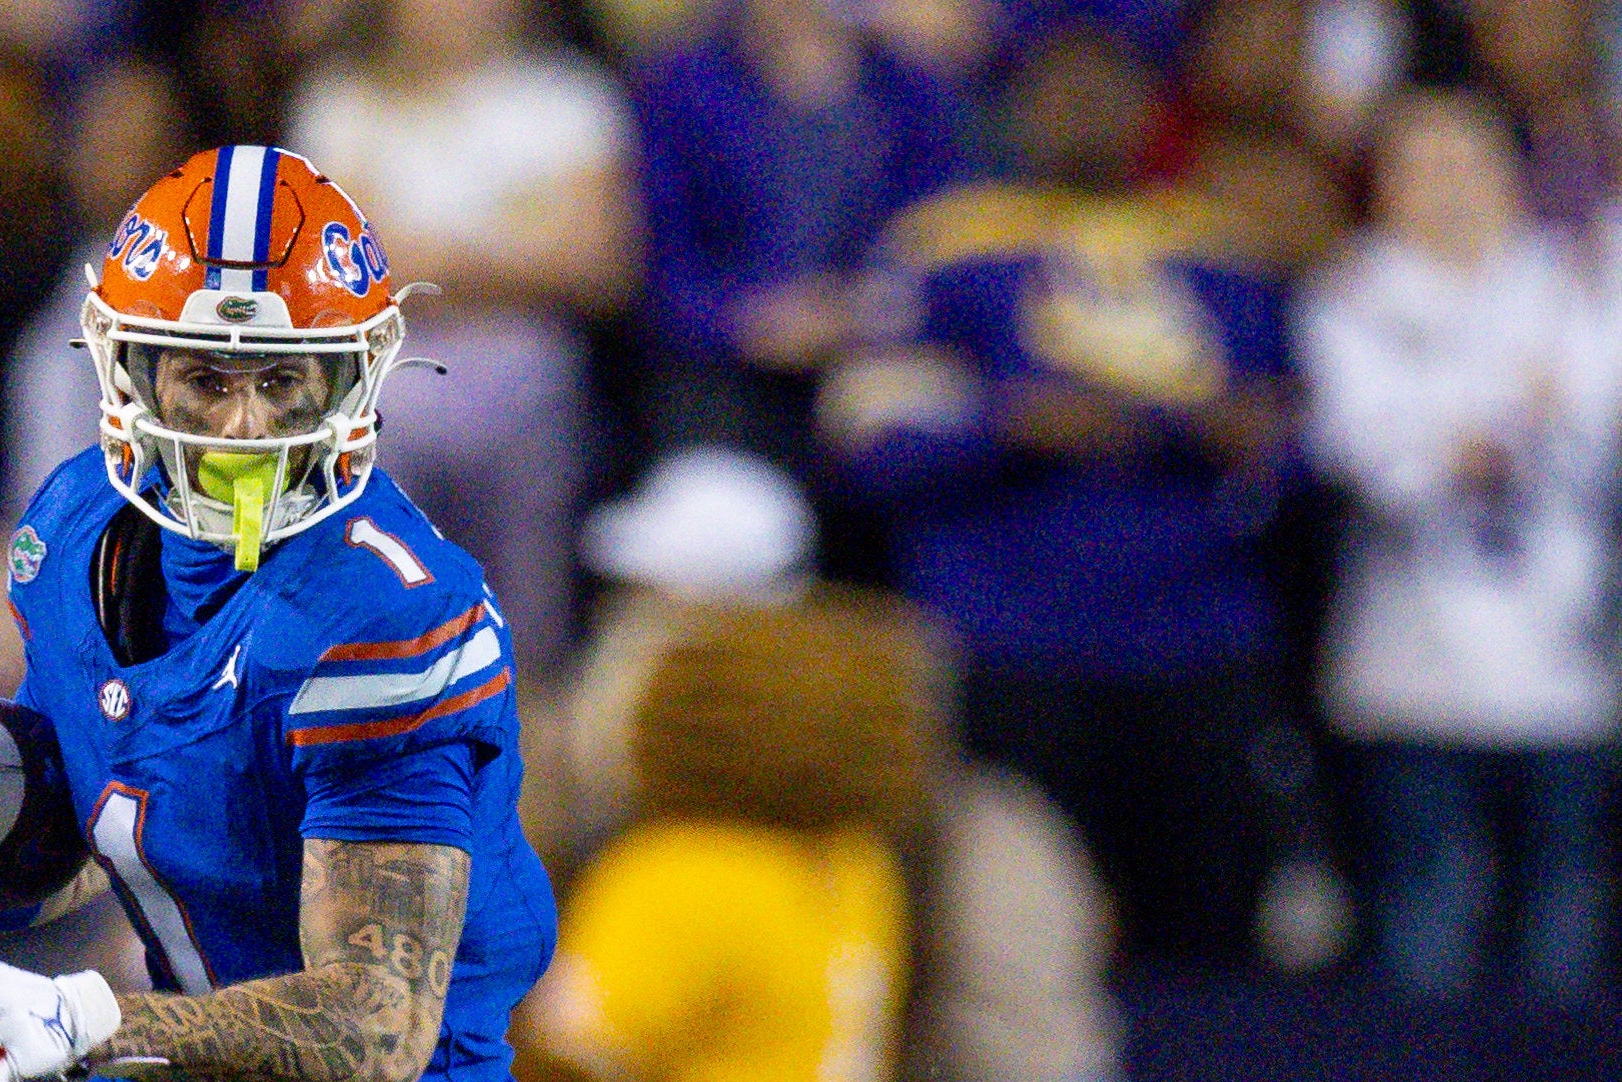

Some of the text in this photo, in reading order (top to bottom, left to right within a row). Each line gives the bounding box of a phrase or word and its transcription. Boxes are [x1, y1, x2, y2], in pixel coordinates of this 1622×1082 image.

[345, 516, 435, 589] 1
[101, 682, 128, 718] SEC
[87, 780, 217, 998] 1
[347, 923, 449, 998] 480
